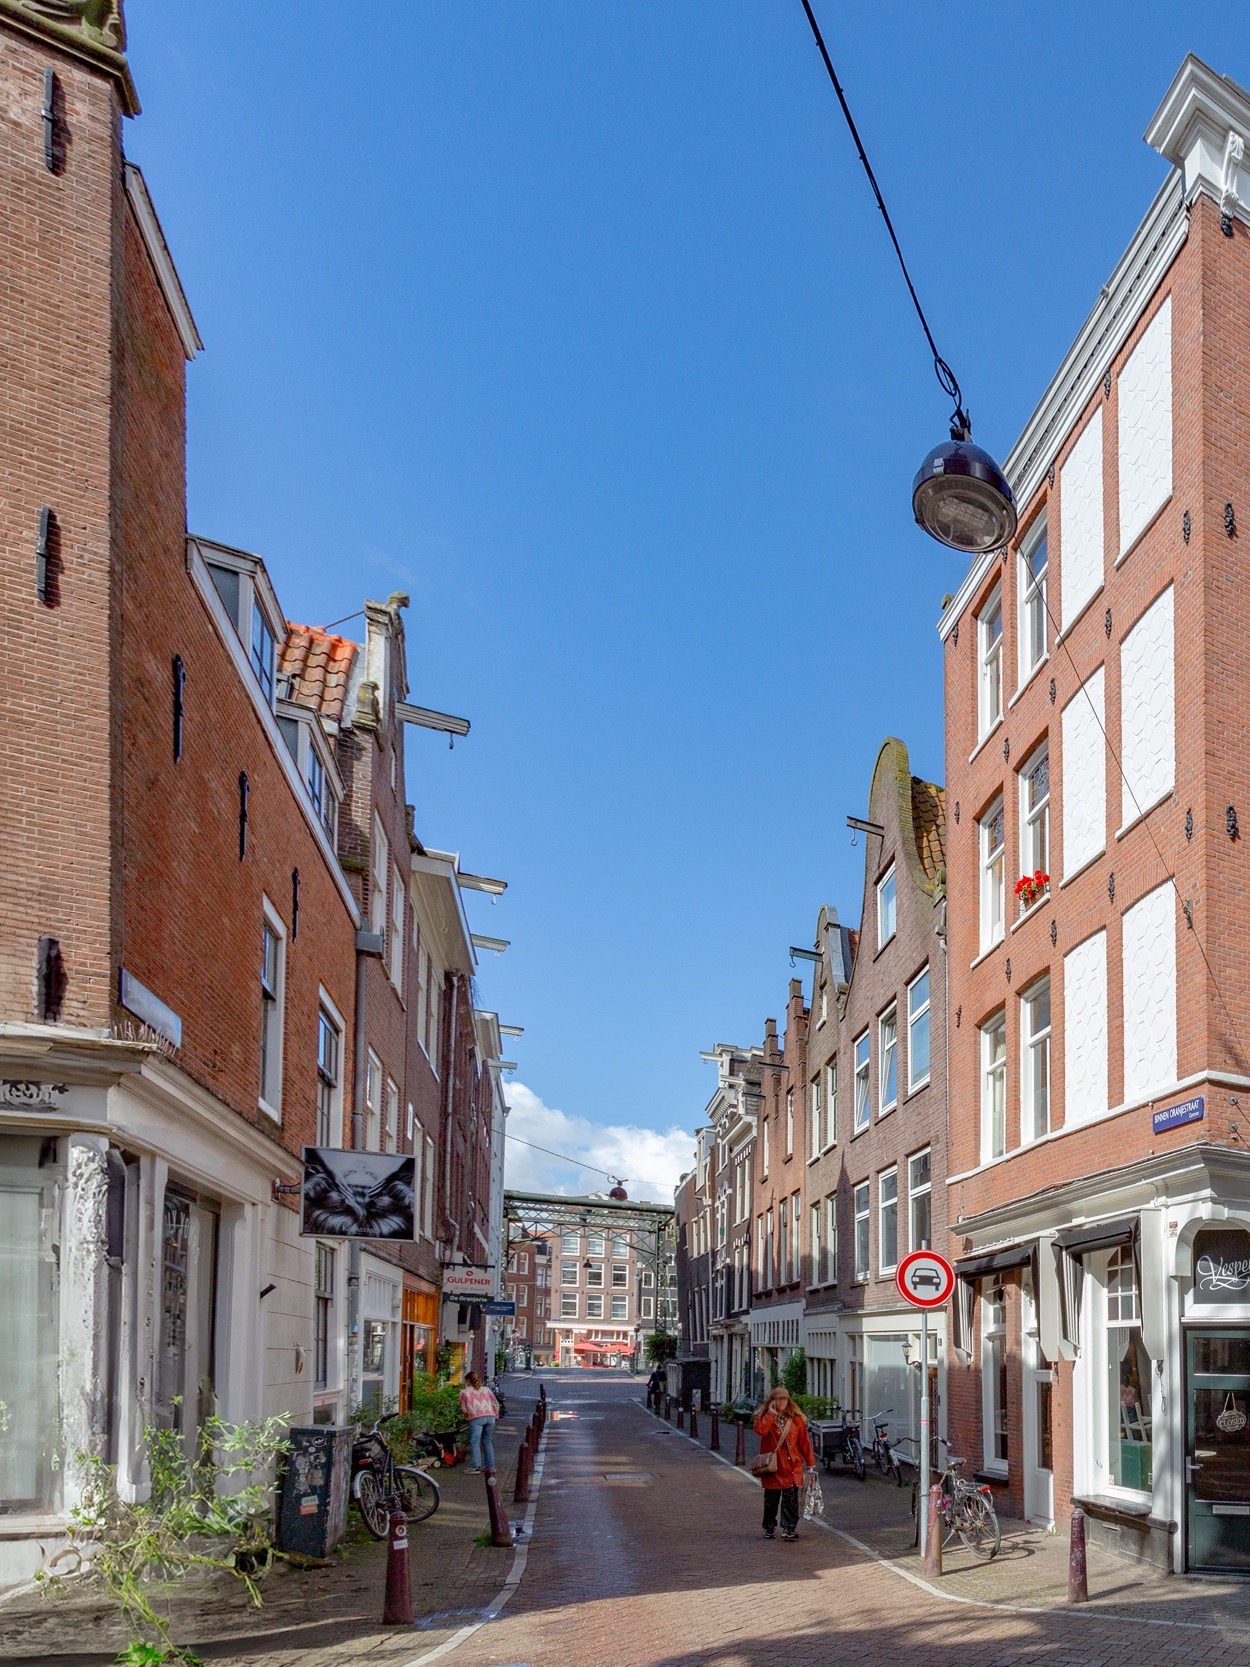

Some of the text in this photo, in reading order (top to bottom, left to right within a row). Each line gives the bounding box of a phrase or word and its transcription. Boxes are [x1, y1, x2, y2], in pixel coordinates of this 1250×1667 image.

[1154, 1100, 1199, 1124] BINNEN ORANJESTRAAT
[447, 1276, 490, 1285] GULPENER
[1219, 1418, 1245, 1428] CLOSED
